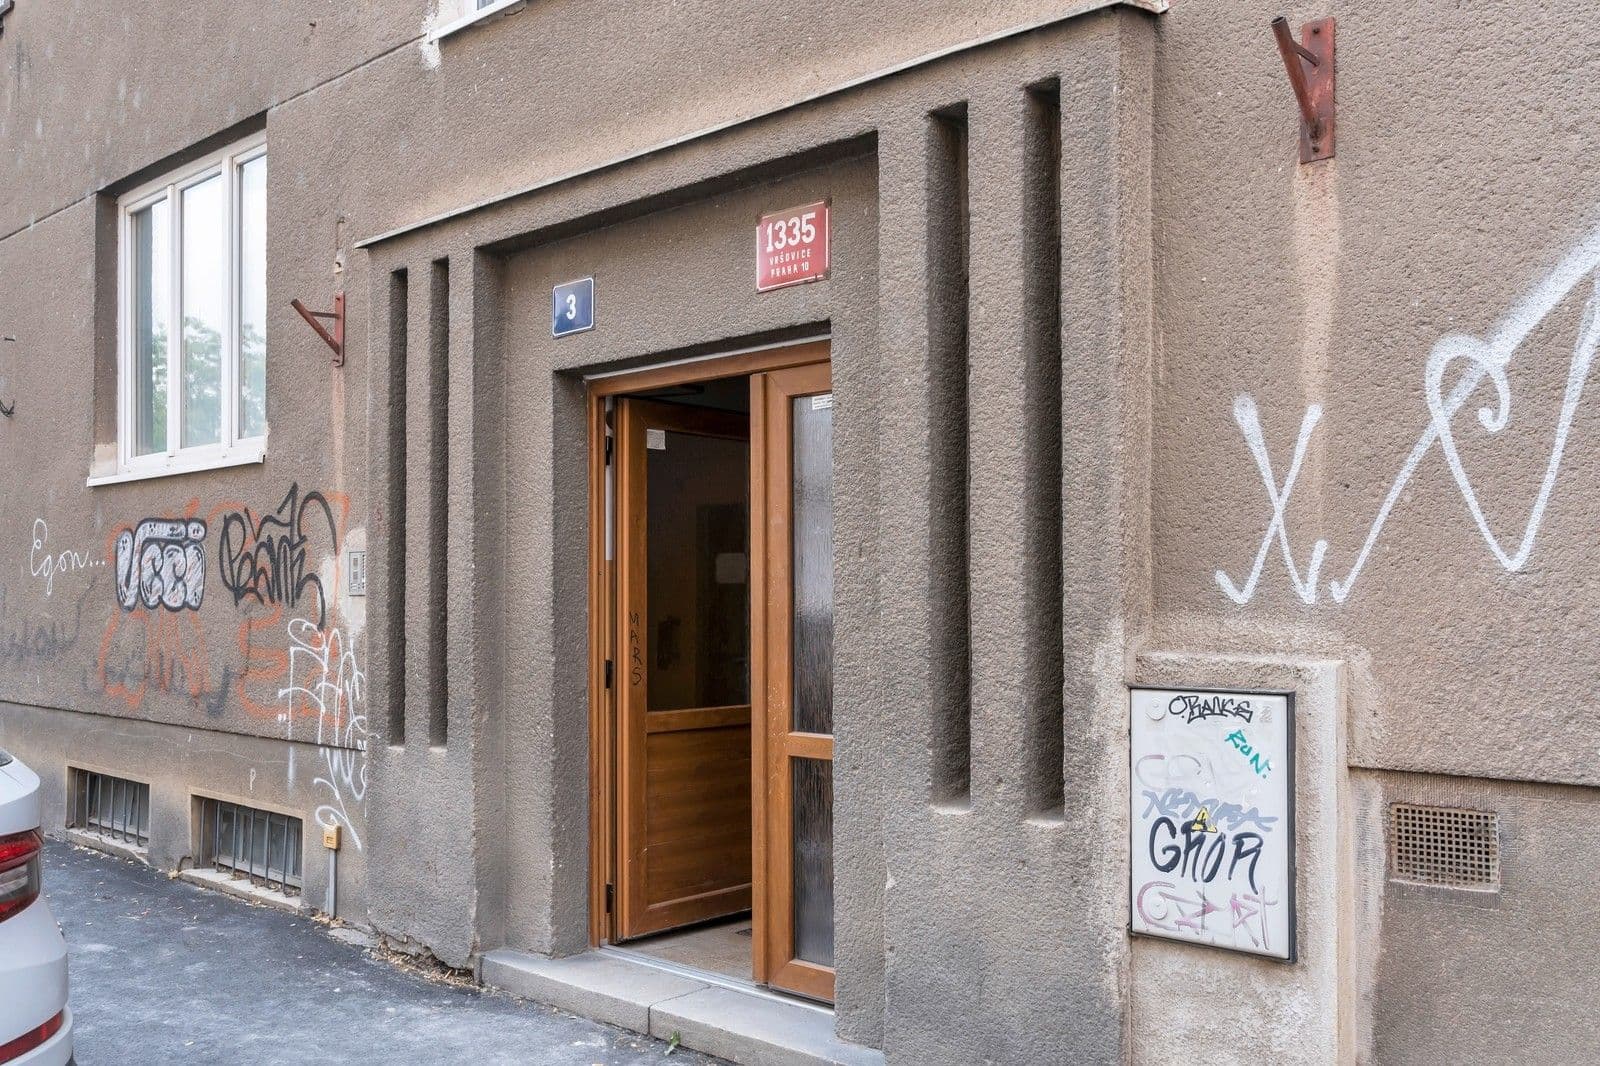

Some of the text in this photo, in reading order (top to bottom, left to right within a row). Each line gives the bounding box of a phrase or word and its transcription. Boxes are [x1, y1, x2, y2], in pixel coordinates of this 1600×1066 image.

[766, 212, 816, 253] 1335
[769, 248, 811, 266] VRŠOVICE
[771, 261, 810, 278] PRAHA 10
[566, 294, 577, 320] 3
